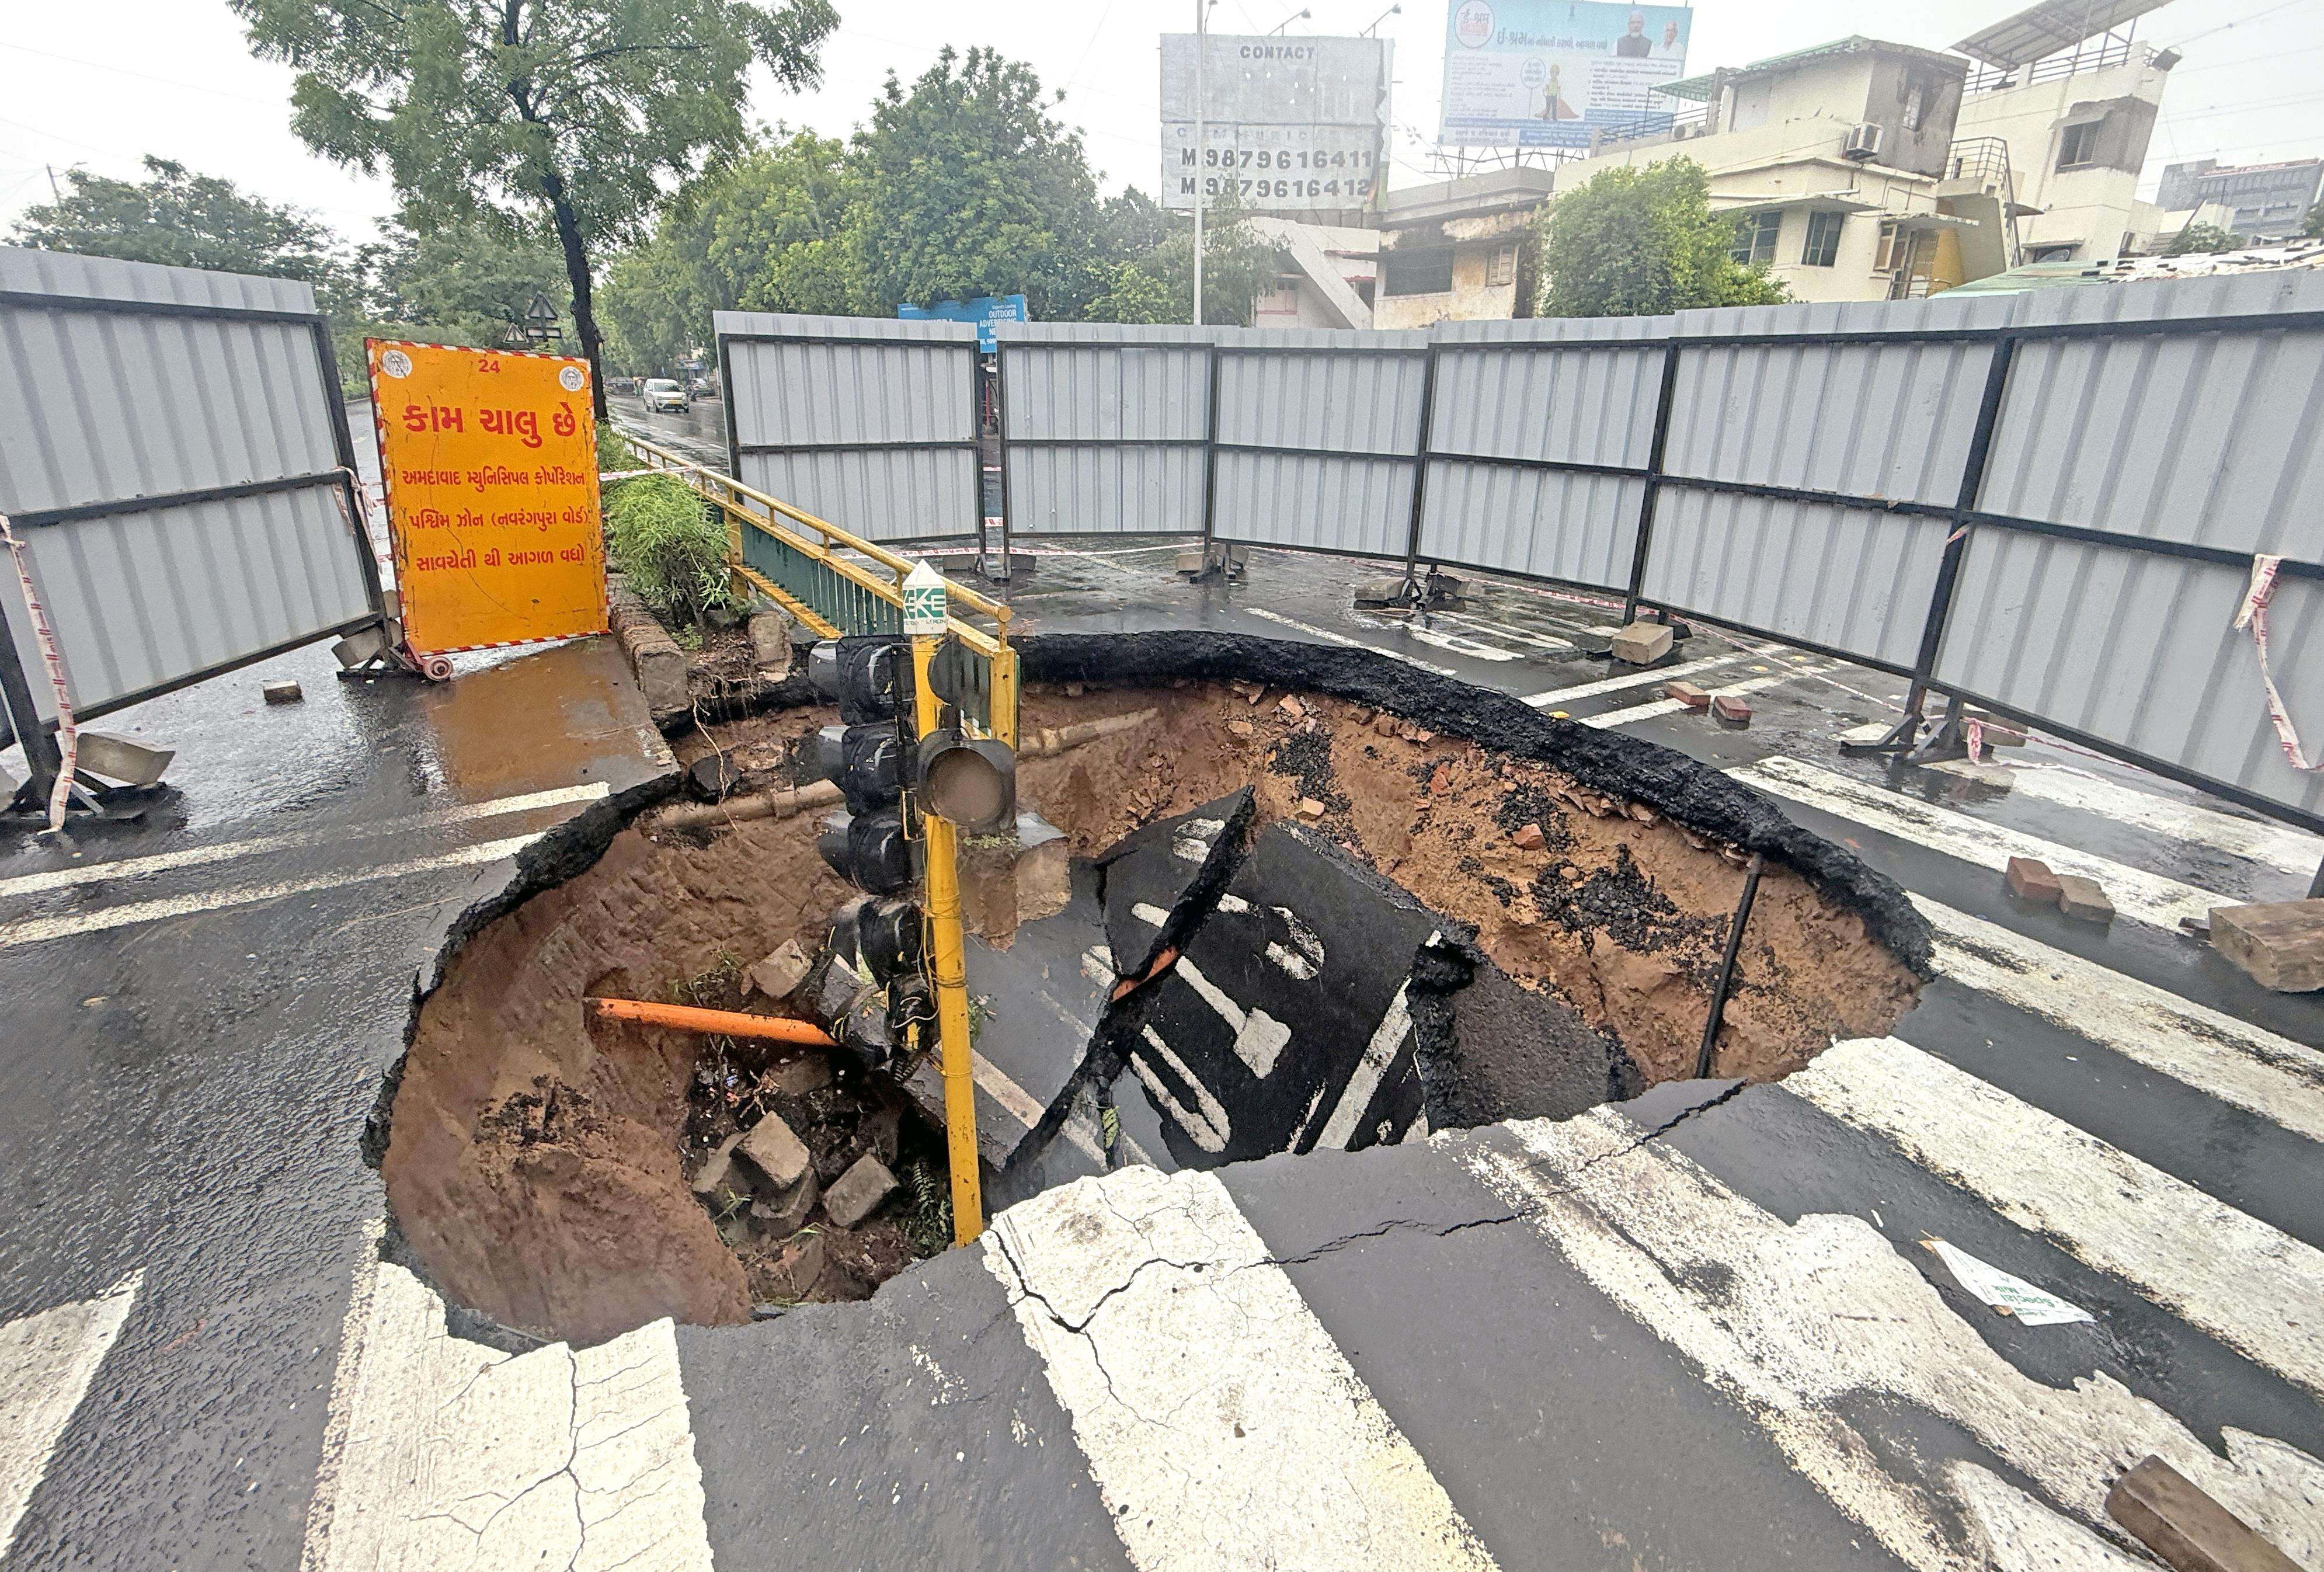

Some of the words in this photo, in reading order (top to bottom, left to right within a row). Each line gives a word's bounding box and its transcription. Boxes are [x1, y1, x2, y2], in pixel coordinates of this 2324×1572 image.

[1240, 46, 1316, 60] CONTACT
[1206, 149, 1371, 169] 9879616411
[989, 309, 1017, 319] OUTDOOR
[478, 359, 500, 374] 24
[402, 405, 464, 433] કામ
[479, 409, 543, 448] ચાલુ
[552, 402, 576, 437] છે
[402, 470, 462, 485] અમદાવાદ
[467, 465, 529, 492] મ્યુનિસિપલ
[409, 508, 450, 529] પશ્ચિમ
[457, 507, 483, 527] ઝોન
[492, 507, 556, 532] (નવરંગપુરા
[562, 505, 589, 524] વોર્ડ)
[416, 548, 476, 571] સાવચેતી
[483, 547, 501, 566] થી
[508, 550, 554, 565] આગળ
[560, 542, 585, 562] વધો
[1991, 1285, 2020, 1295] Milk
